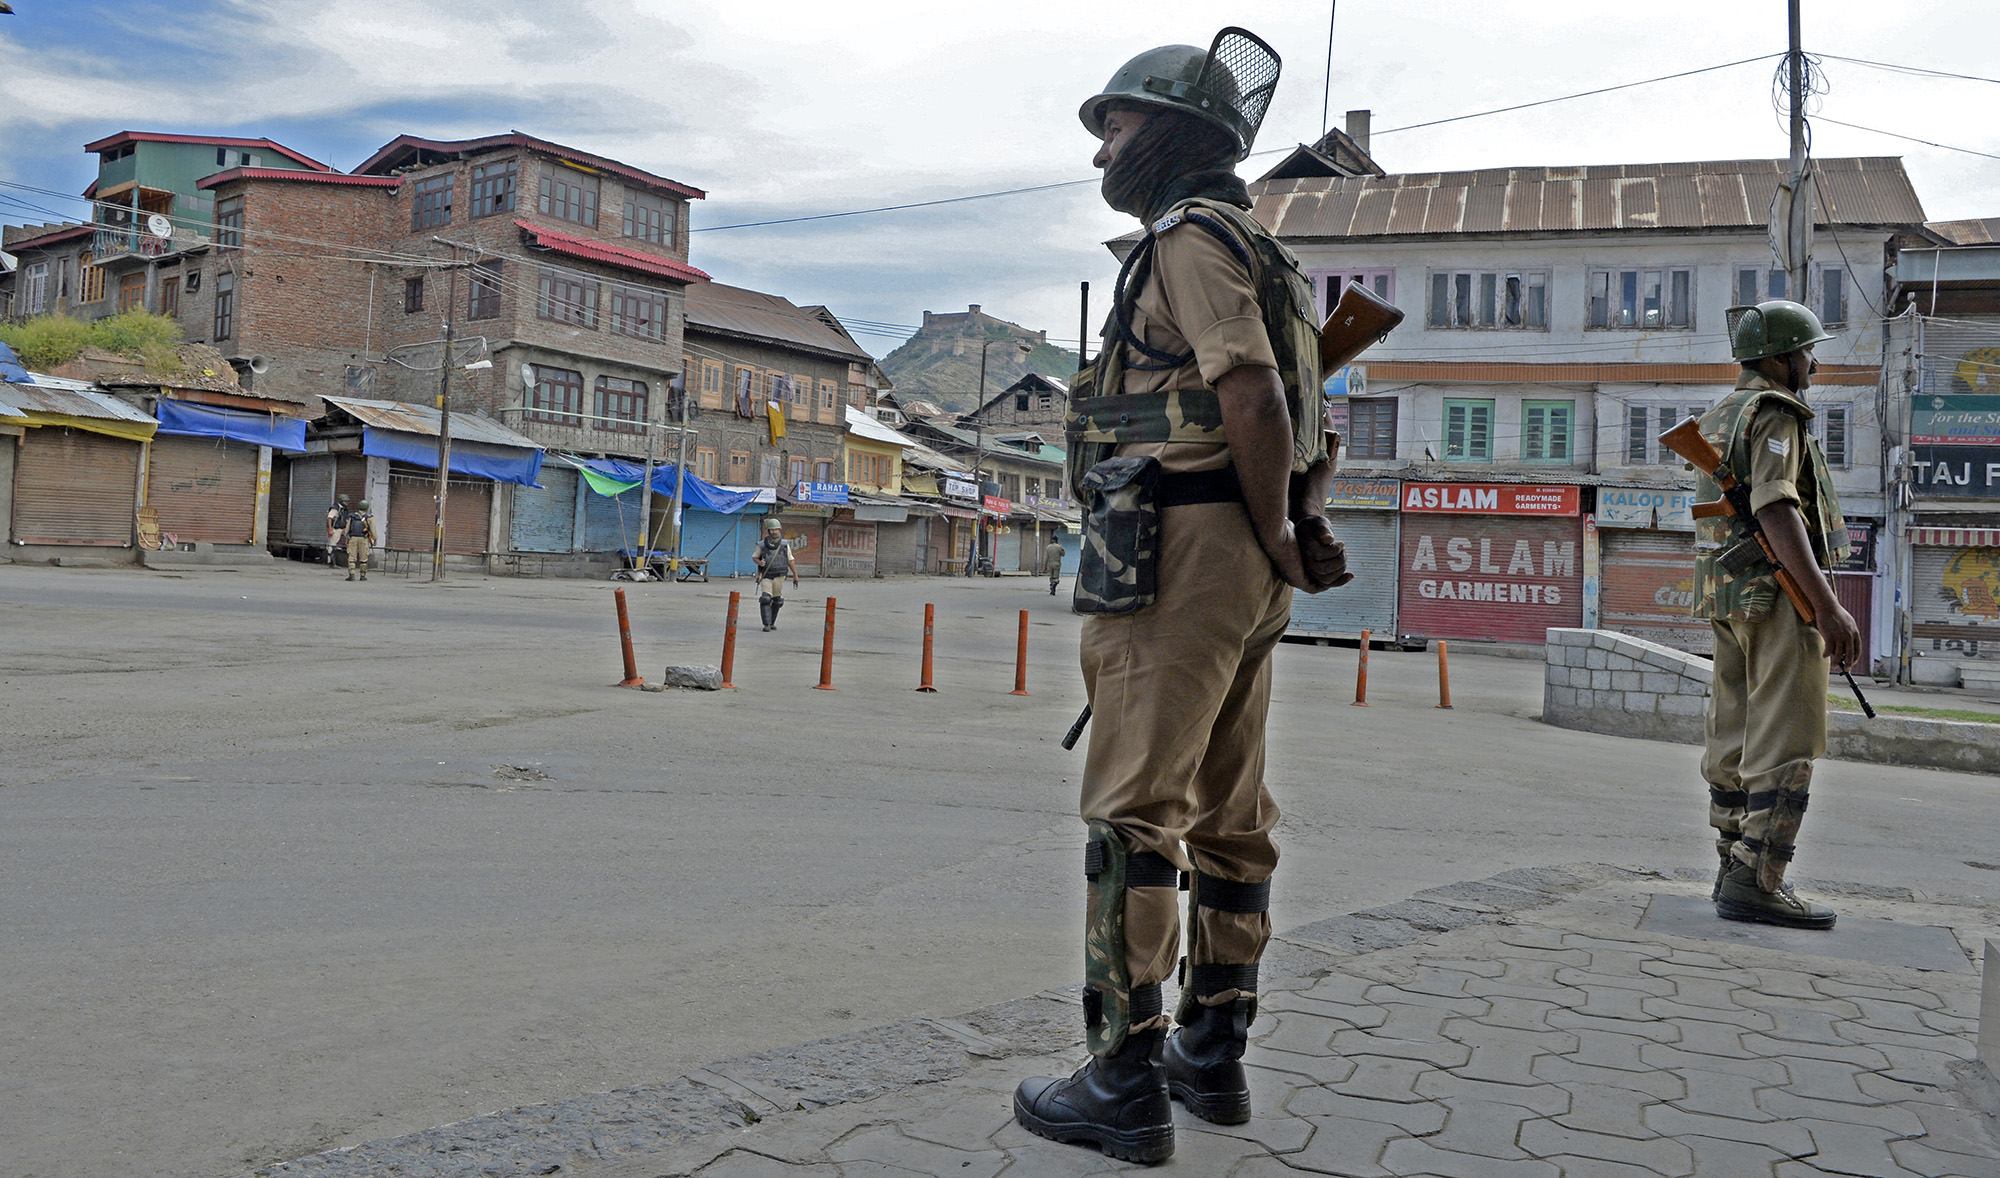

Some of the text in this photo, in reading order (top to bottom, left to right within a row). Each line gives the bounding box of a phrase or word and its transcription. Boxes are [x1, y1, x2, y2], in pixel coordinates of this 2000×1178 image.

[1928, 412, 1954, 425] for
[1957, 412, 1981, 423] the
[1949, 425, 1978, 435] and
[1912, 461, 1971, 485] TAJ
[817, 483, 843, 492] RAHAT
[1333, 481, 1398, 496] Fashion
[1406, 487, 1498, 510] ASLAM
[1515, 494, 1562, 502] READYMADE
[1603, 492, 1665, 507] KALOO
[827, 528, 875, 550] NEULITE
[1586, 514, 1598, 561] ASLAM
[1411, 535, 1575, 577] ASLAM
[1419, 579, 1562, 605] GARMENTS
